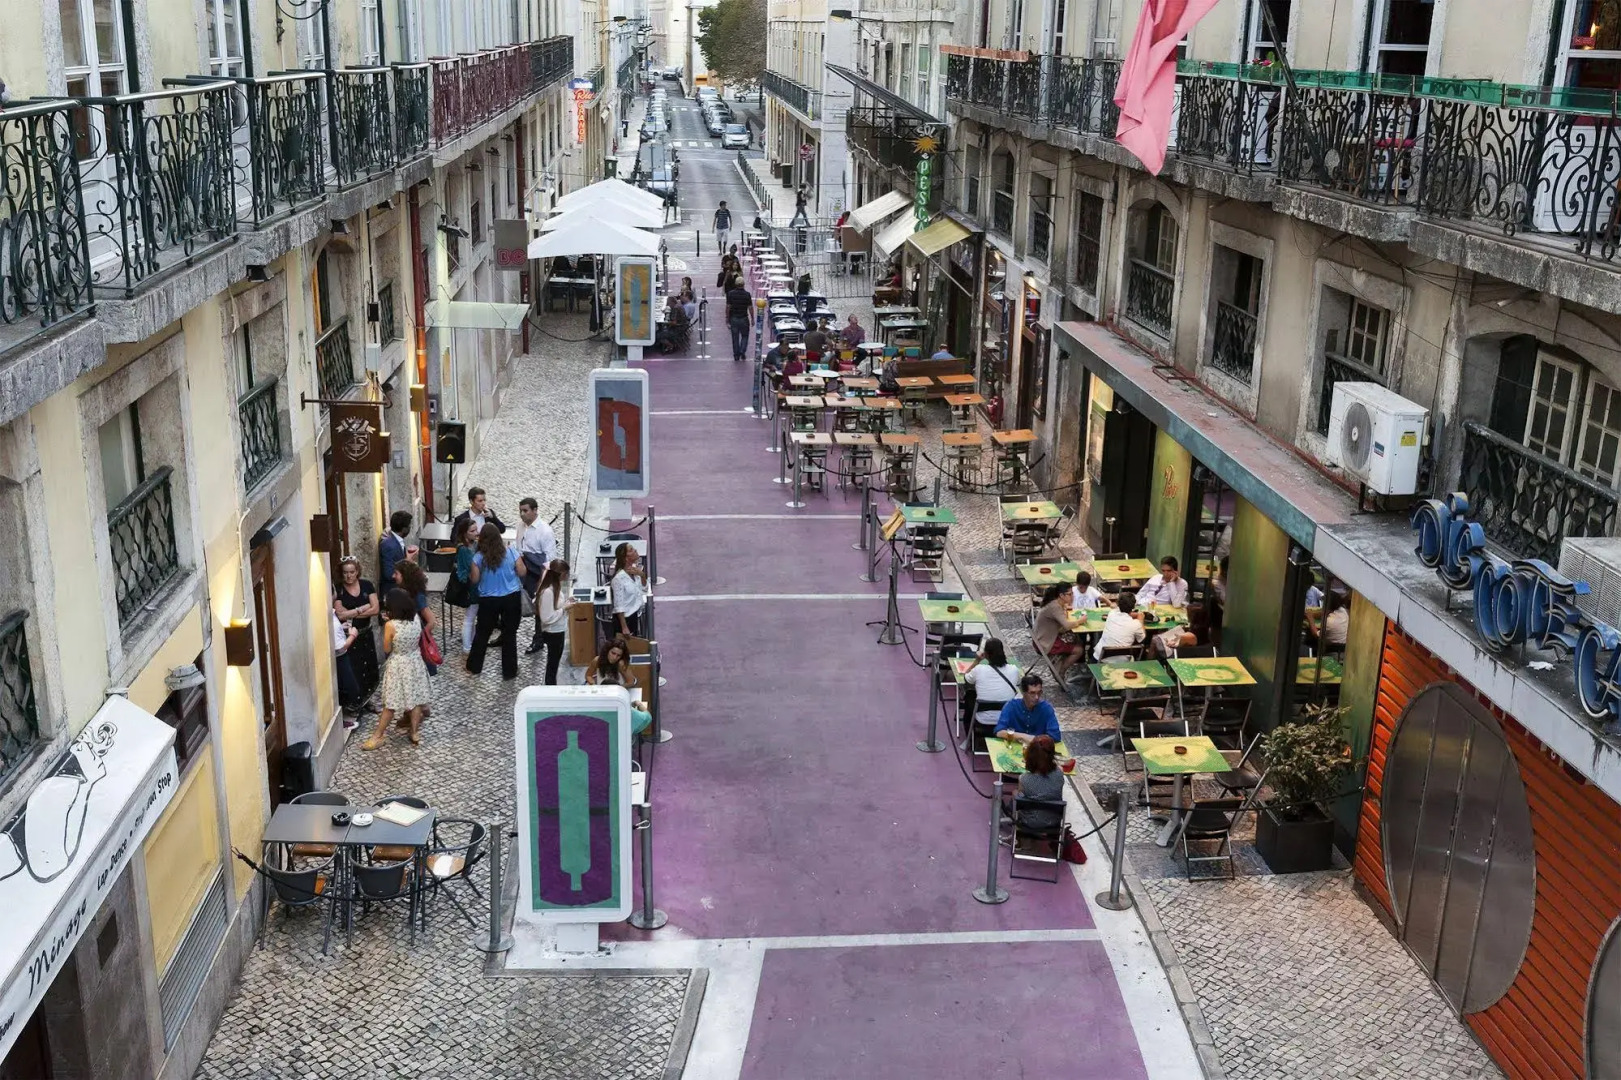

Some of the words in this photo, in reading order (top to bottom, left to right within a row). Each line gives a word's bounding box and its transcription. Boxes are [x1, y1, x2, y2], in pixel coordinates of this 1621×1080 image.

[916, 124, 936, 139] SOL
[918, 160, 929, 232] PESCA
[97, 868, 109, 891] Lap
[157, 772, 172, 795] Stop
[28, 897, 87, 1000] Ménage
